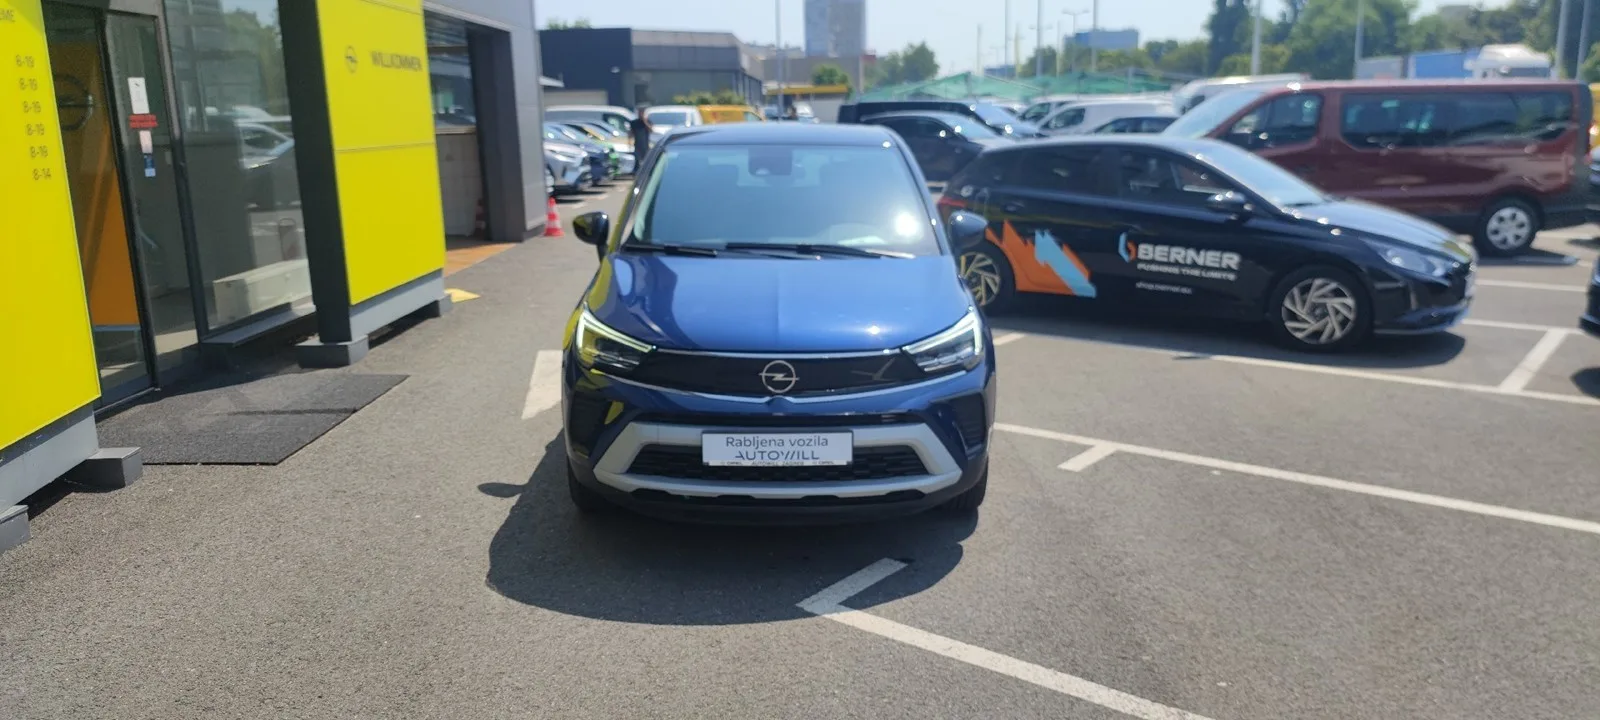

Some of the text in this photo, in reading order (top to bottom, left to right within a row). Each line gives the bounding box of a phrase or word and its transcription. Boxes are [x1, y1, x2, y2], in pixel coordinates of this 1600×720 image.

[1137, 243, 1241, 270] BERNER
[725, 435, 829, 449] Rabljena vozila
[735, 450, 820, 461] AUTOWILL
